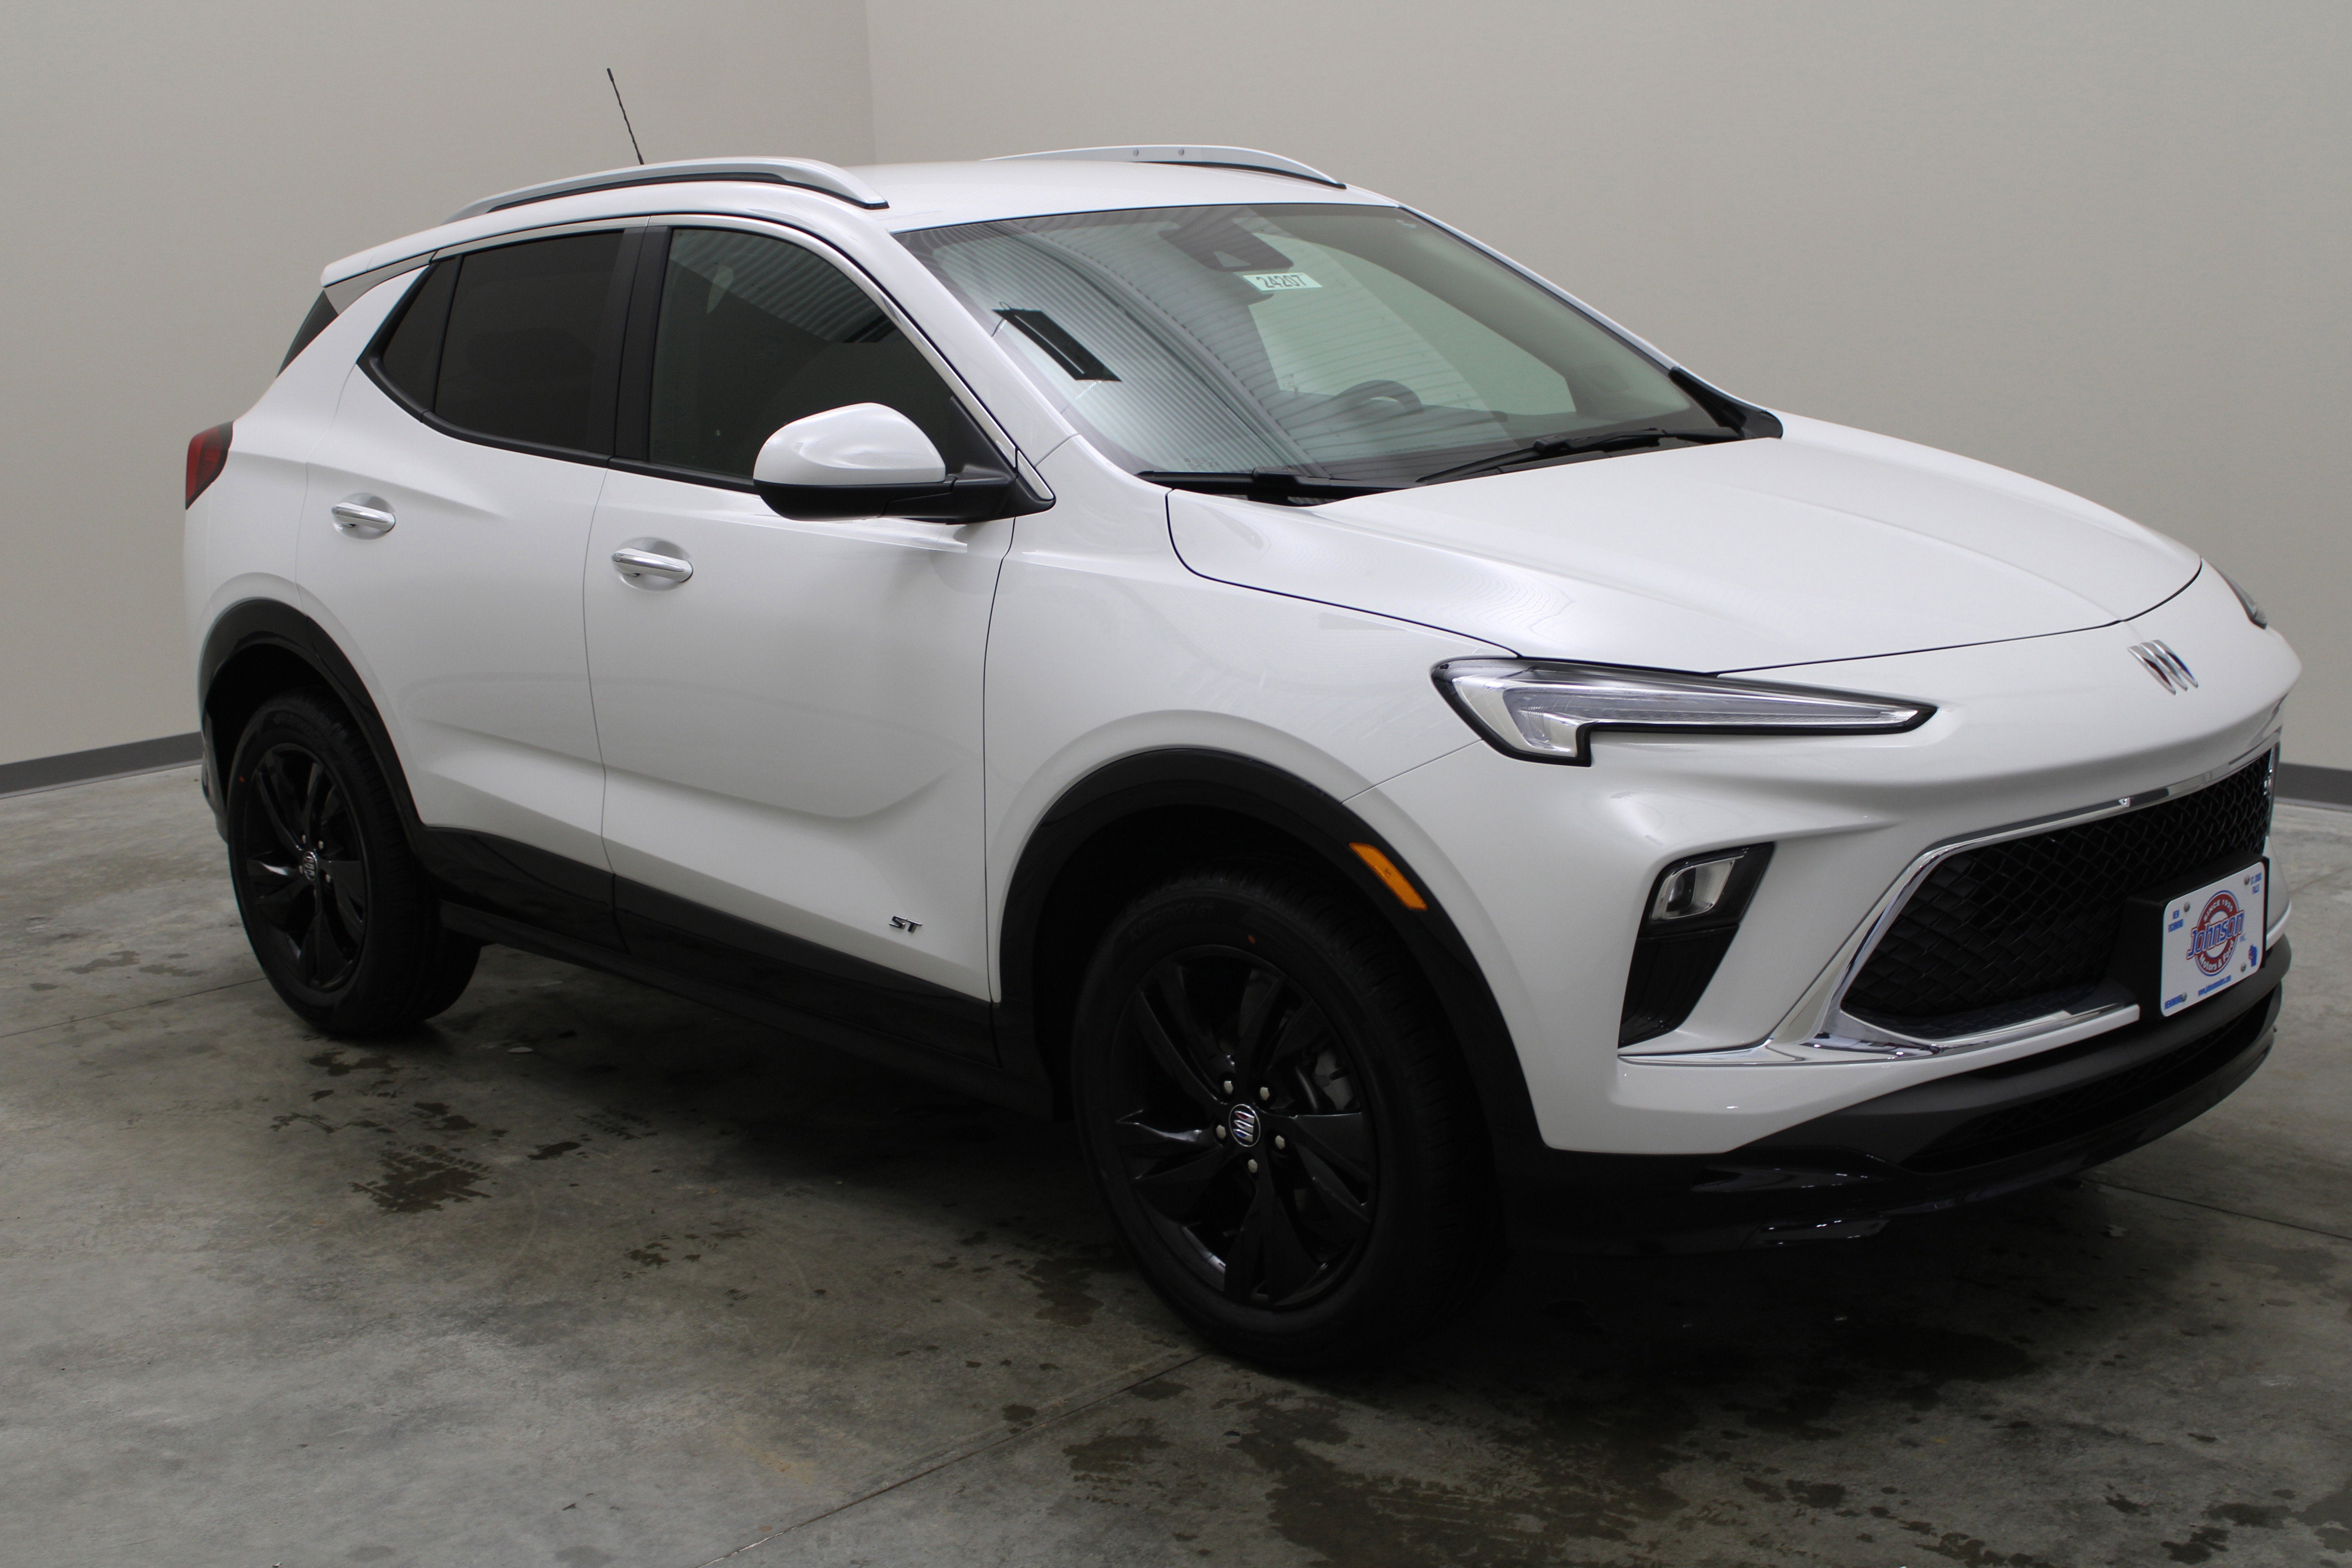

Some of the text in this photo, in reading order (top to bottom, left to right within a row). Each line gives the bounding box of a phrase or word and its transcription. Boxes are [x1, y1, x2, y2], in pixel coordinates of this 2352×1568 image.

[1256, 275, 1307, 288] 24207
[2204, 899, 2221, 922] SINCE
[889, 915, 922, 933] ST
[2187, 911, 2244, 960] Johnson
[2200, 953, 2217, 971] Motors
[2218, 958, 2222, 968] &
